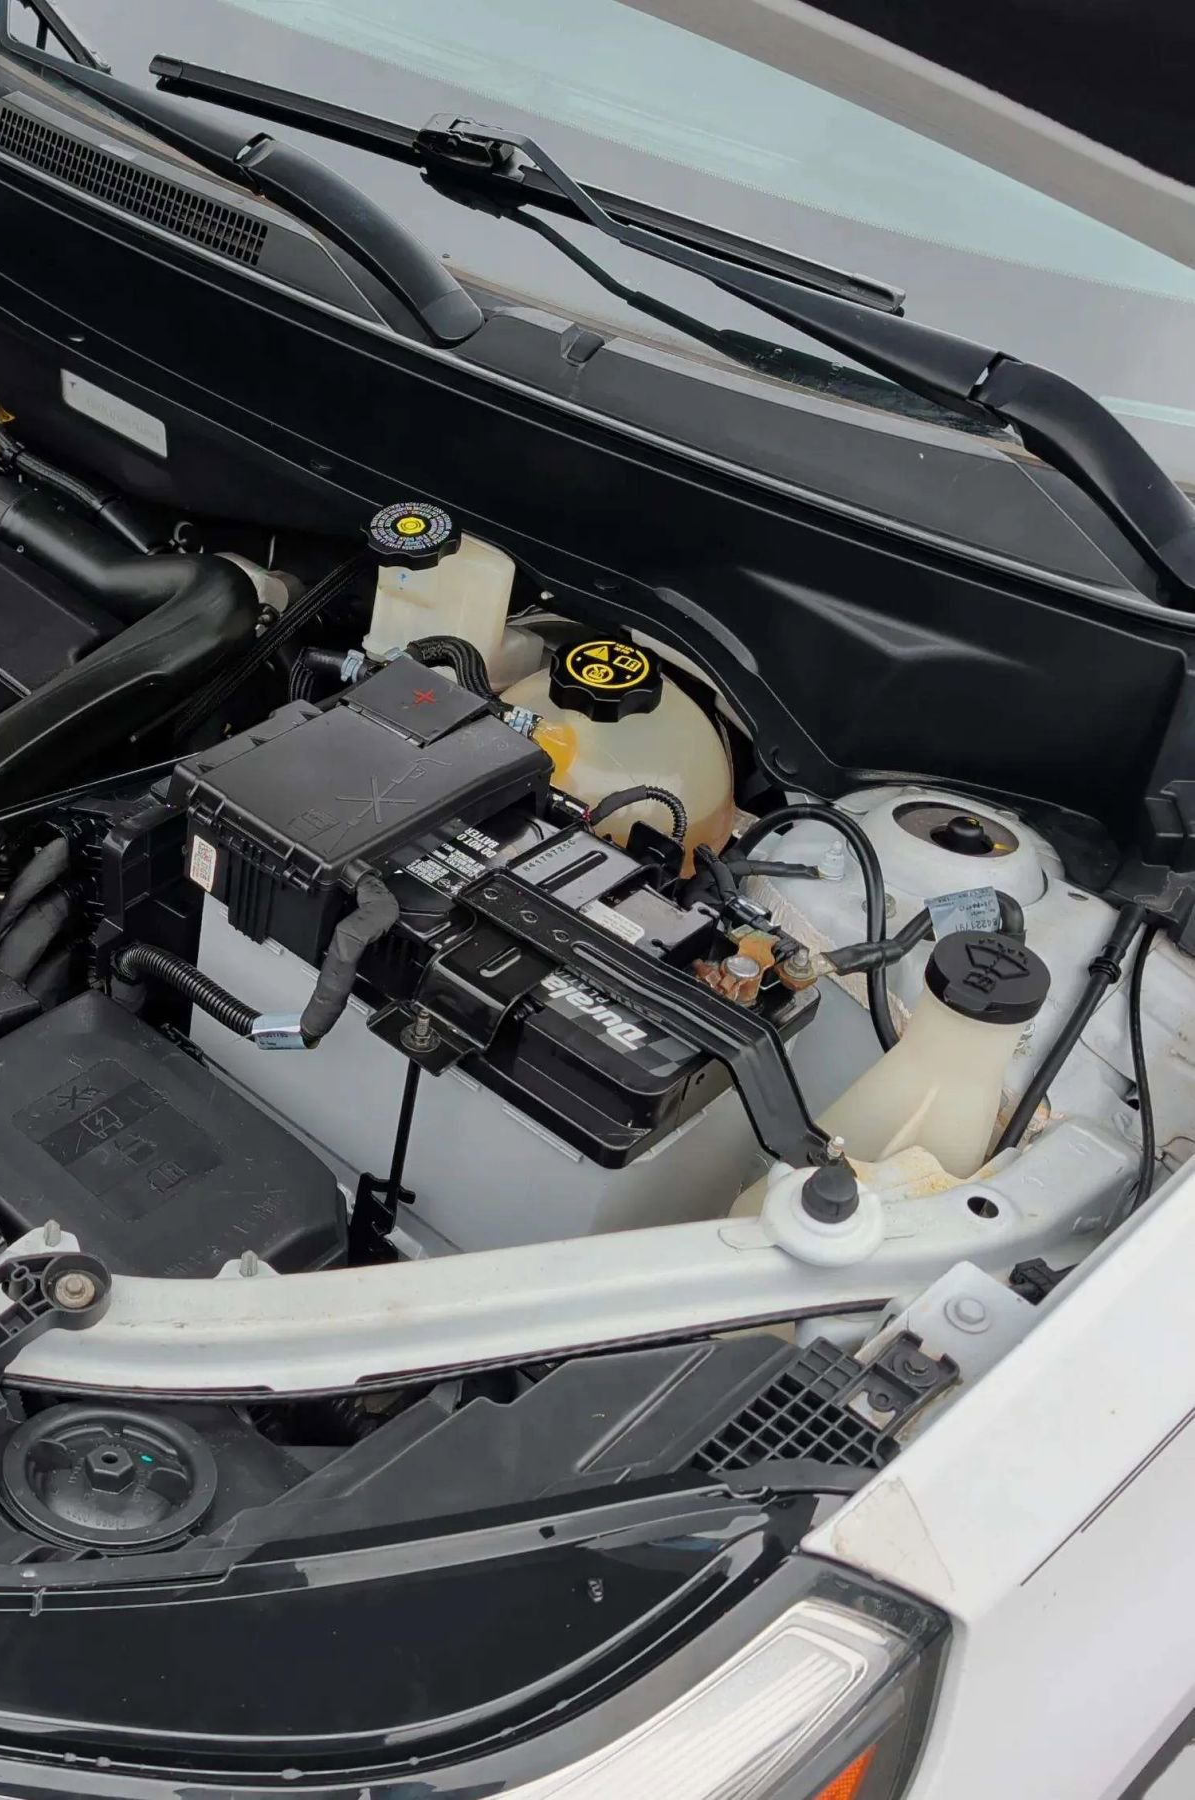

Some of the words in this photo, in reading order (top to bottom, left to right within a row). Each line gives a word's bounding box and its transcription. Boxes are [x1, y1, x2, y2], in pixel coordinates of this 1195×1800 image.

[462, 837, 485, 851] NOT
[464, 827, 500, 849] BATTER
[480, 847, 497, 859] DO
[540, 973, 648, 1051] Durala
